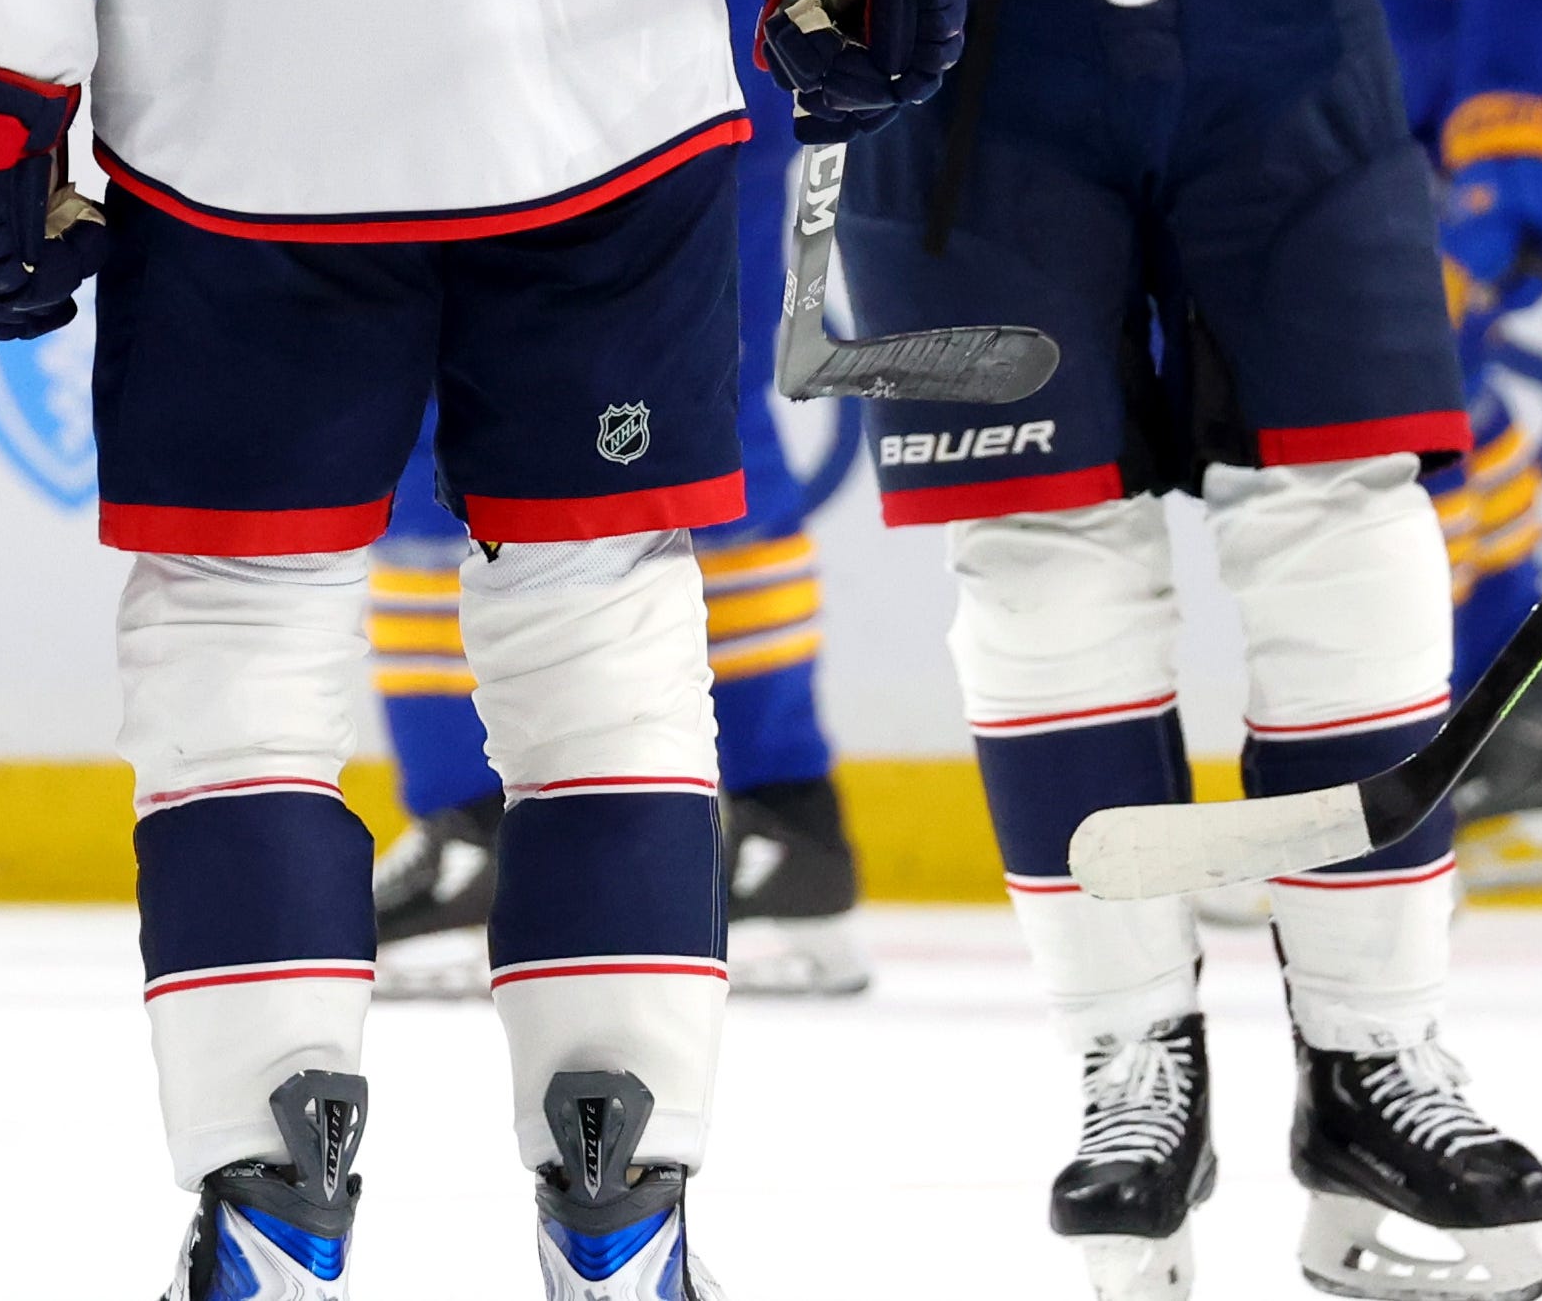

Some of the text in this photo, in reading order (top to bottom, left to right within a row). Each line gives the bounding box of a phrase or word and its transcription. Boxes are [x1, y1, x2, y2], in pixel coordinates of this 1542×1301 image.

[801, 143, 847, 236] CM
[610, 419, 639, 451] NHL
[879, 419, 1055, 468] BAUER
